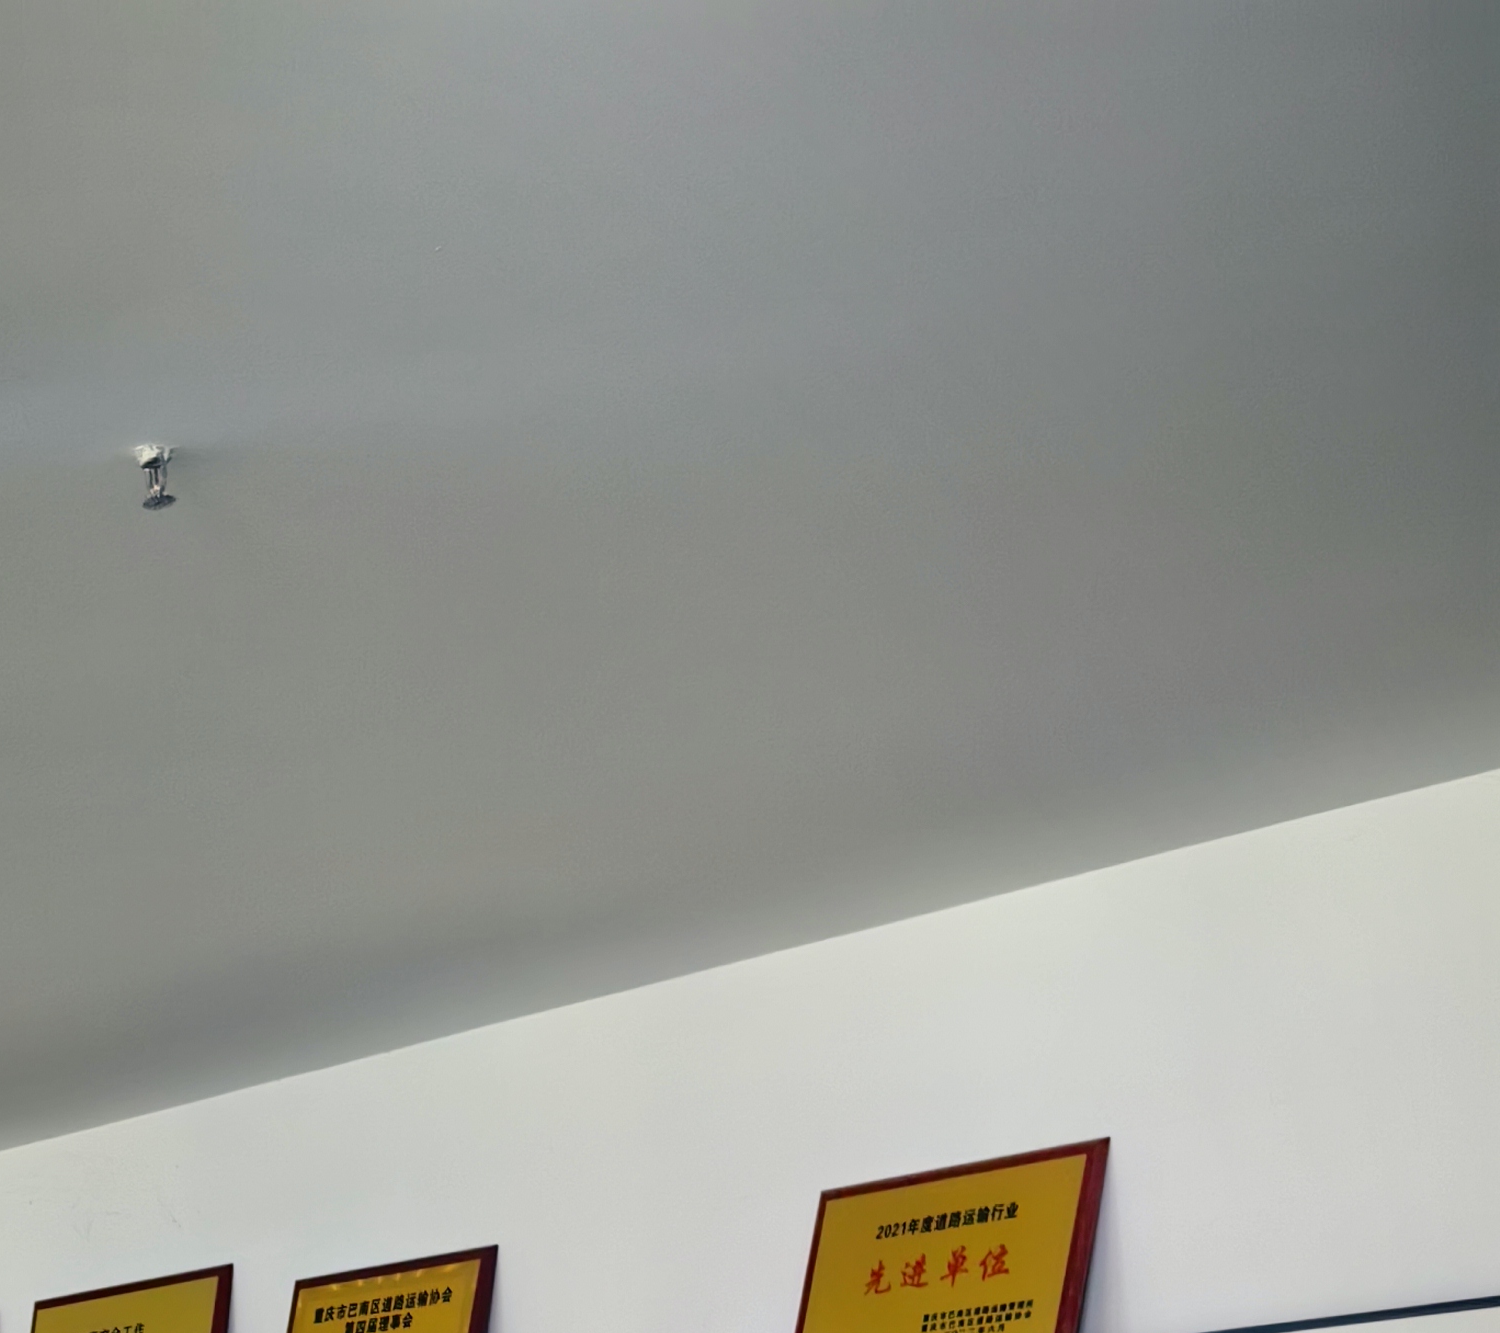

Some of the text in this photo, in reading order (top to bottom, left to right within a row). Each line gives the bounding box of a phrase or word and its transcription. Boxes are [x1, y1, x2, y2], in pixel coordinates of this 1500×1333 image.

[876, 1201, 1019, 1240] 2021年度道路运输行业
[864, 1243, 1010, 1297] 先进单位
[313, 1287, 453, 1324] 重庆市巴南区道路运输协会
